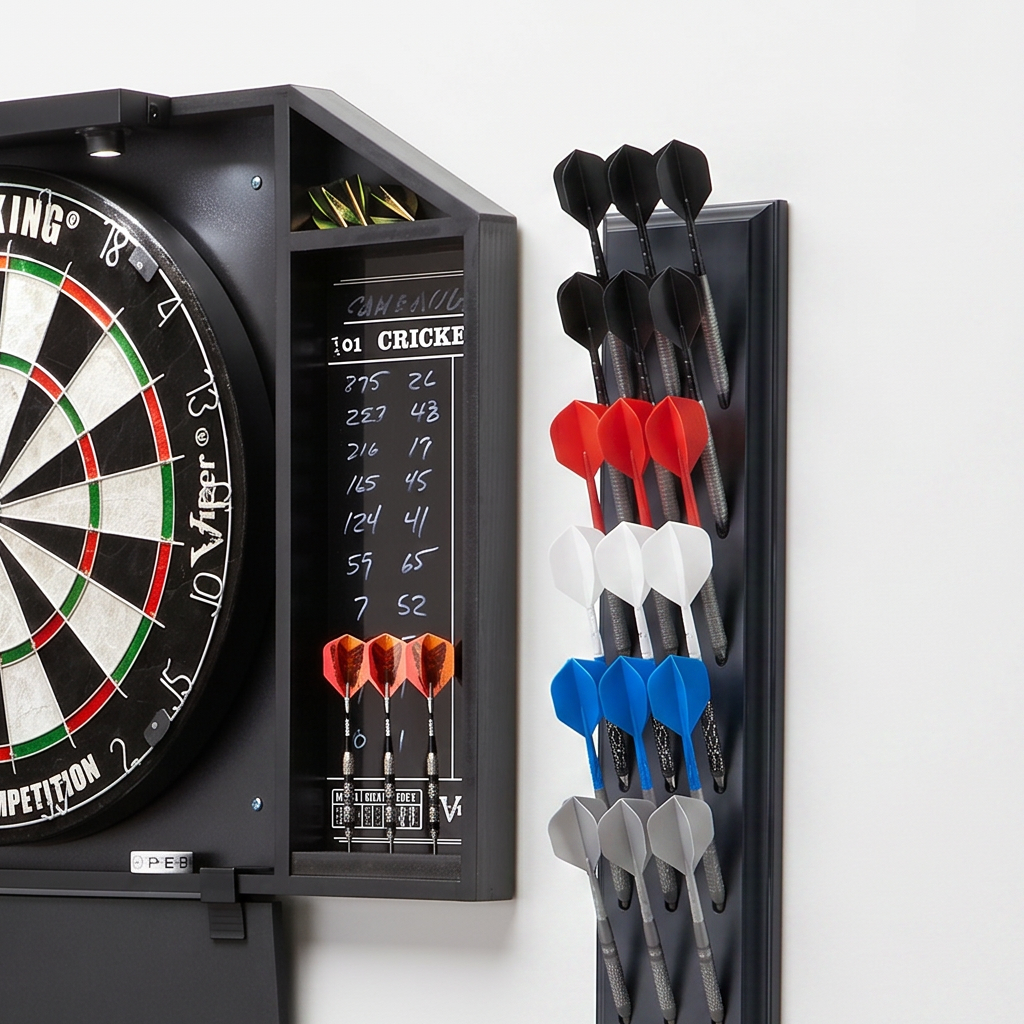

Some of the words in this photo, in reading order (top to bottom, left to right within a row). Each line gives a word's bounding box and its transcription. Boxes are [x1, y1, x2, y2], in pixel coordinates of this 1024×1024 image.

[405, 469, 433, 492] 45
[343, 504, 382, 535] 124
[404, 505, 430, 538] 41
[401, 546, 439, 574] 65
[354, 596, 369, 621] 7
[397, 594, 427, 616] 52
